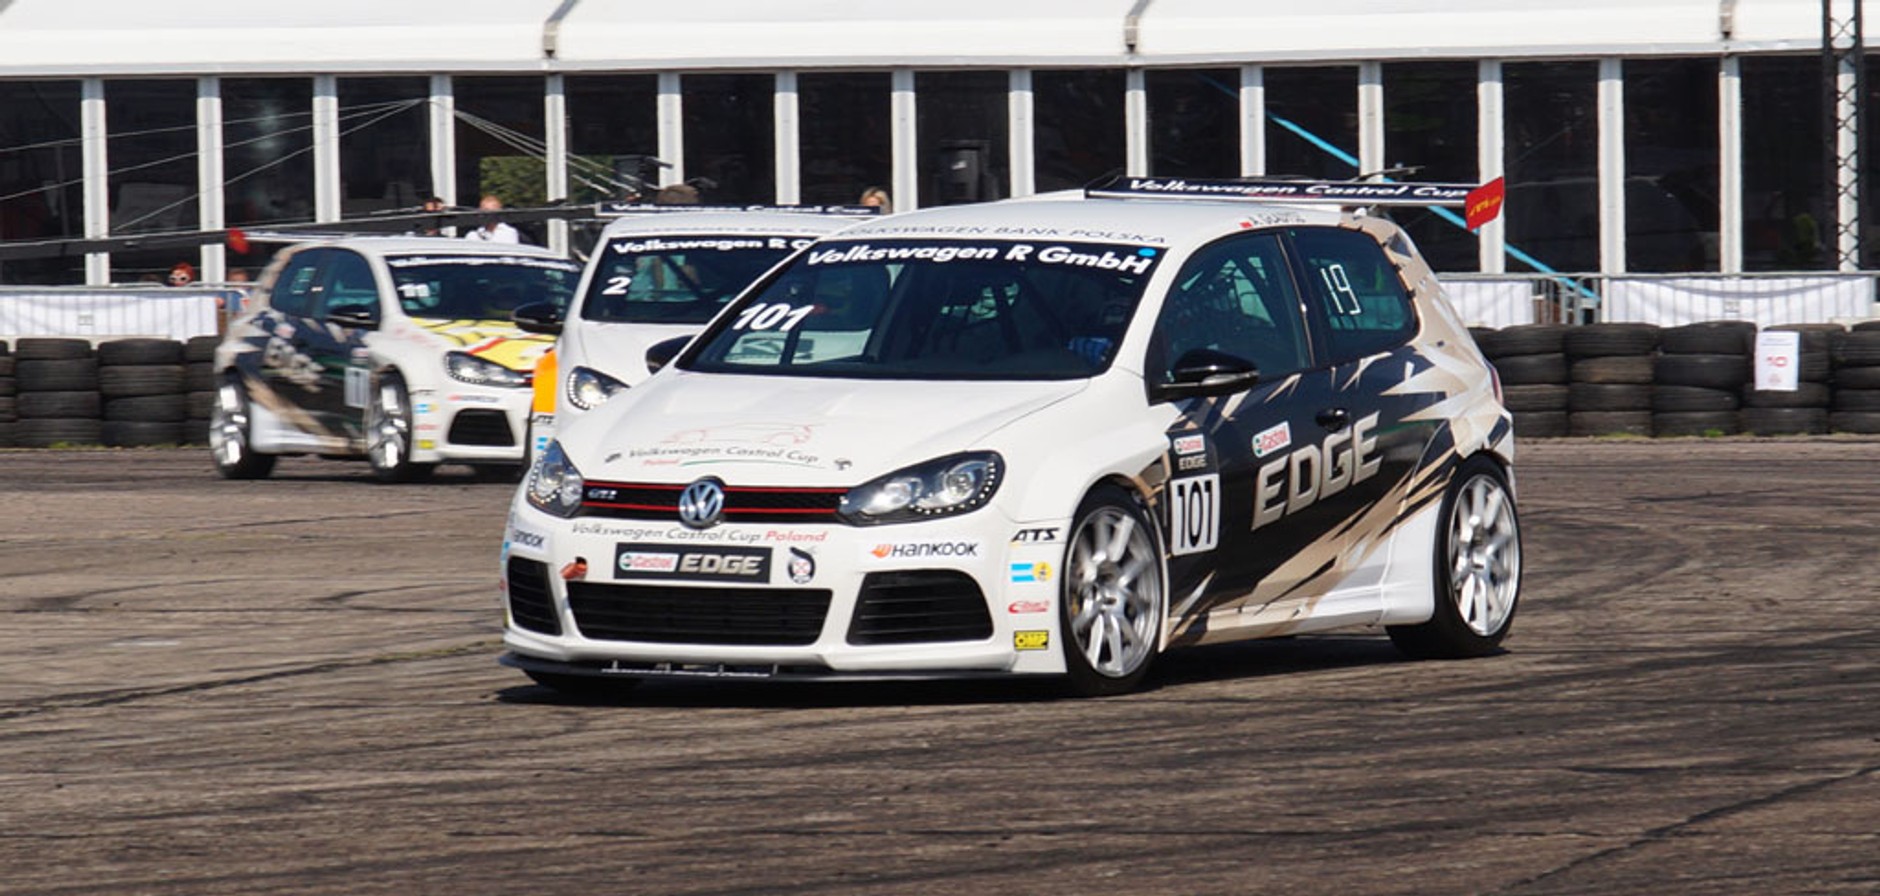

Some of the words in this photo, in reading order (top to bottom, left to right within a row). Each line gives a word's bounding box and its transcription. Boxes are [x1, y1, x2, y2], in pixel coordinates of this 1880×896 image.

[1130, 178, 1297, 195] Volkswagen
[1304, 183, 1410, 197] Castrol
[1412, 185, 1469, 200] Cup
[615, 238, 763, 254] Volkswagen
[767, 238, 787, 250] R
[993, 227, 1059, 237] BANK
[1069, 229, 1167, 244] POLSKA
[807, 243, 999, 266] Volkswagen
[1004, 244, 1034, 262] R
[1037, 246, 1153, 275] GmbH
[601, 276, 632, 296] 2
[1320, 263, 1362, 316] 19
[732, 302, 815, 332] 101
[1250, 411, 1384, 532] EDGE
[1177, 479, 1213, 550] 101
[571, 522, 664, 541] Volkswagen
[665, 528, 725, 542] Castrol
[727, 530, 762, 544] Cup
[763, 530, 829, 543] Poland
[1010, 526, 1061, 543] ATS
[678, 553, 764, 575] EDGE
